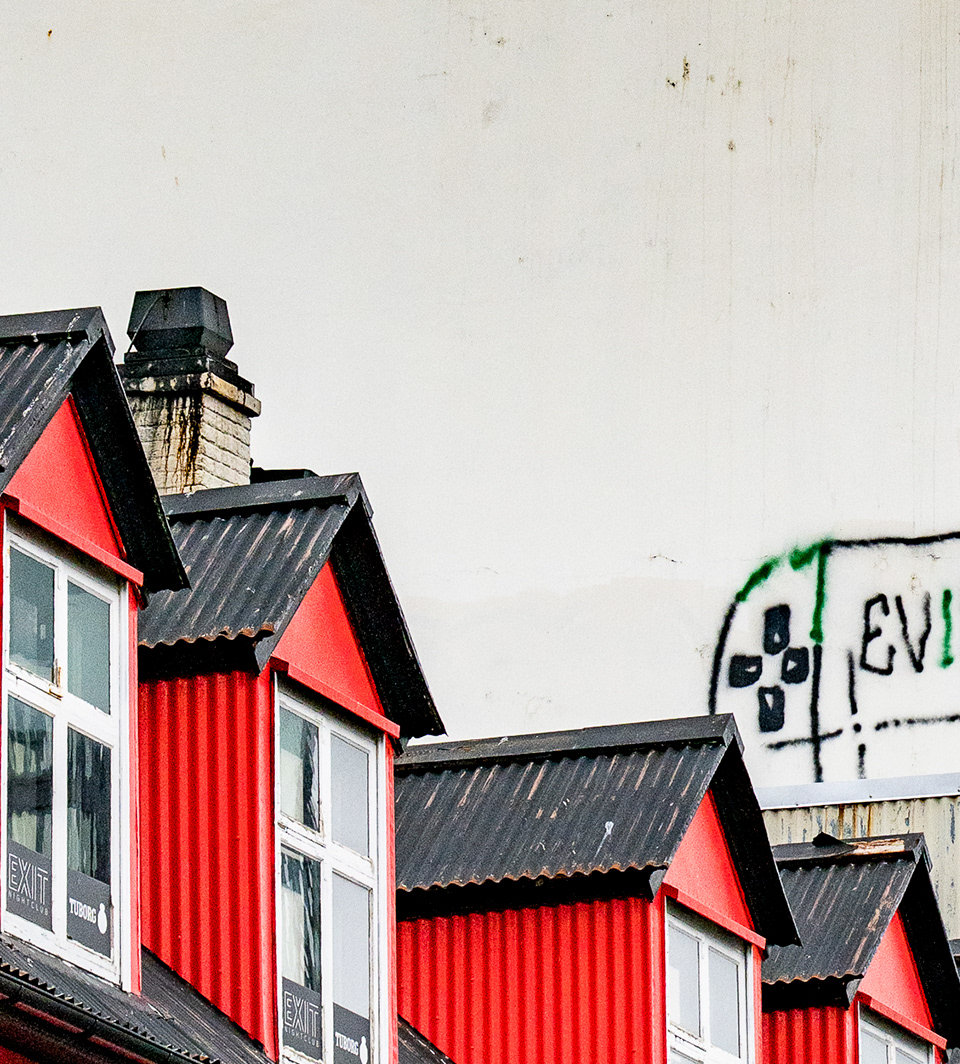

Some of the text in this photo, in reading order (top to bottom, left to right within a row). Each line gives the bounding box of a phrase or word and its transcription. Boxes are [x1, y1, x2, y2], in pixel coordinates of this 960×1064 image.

[9, 852, 49, 906] EXIT
[8, 891, 49, 916] NIGHTCLUB
[69, 897, 97, 924] TUBORG
[284, 990, 319, 1039] EXIT
[335, 1031, 359, 1056] TUBORG
